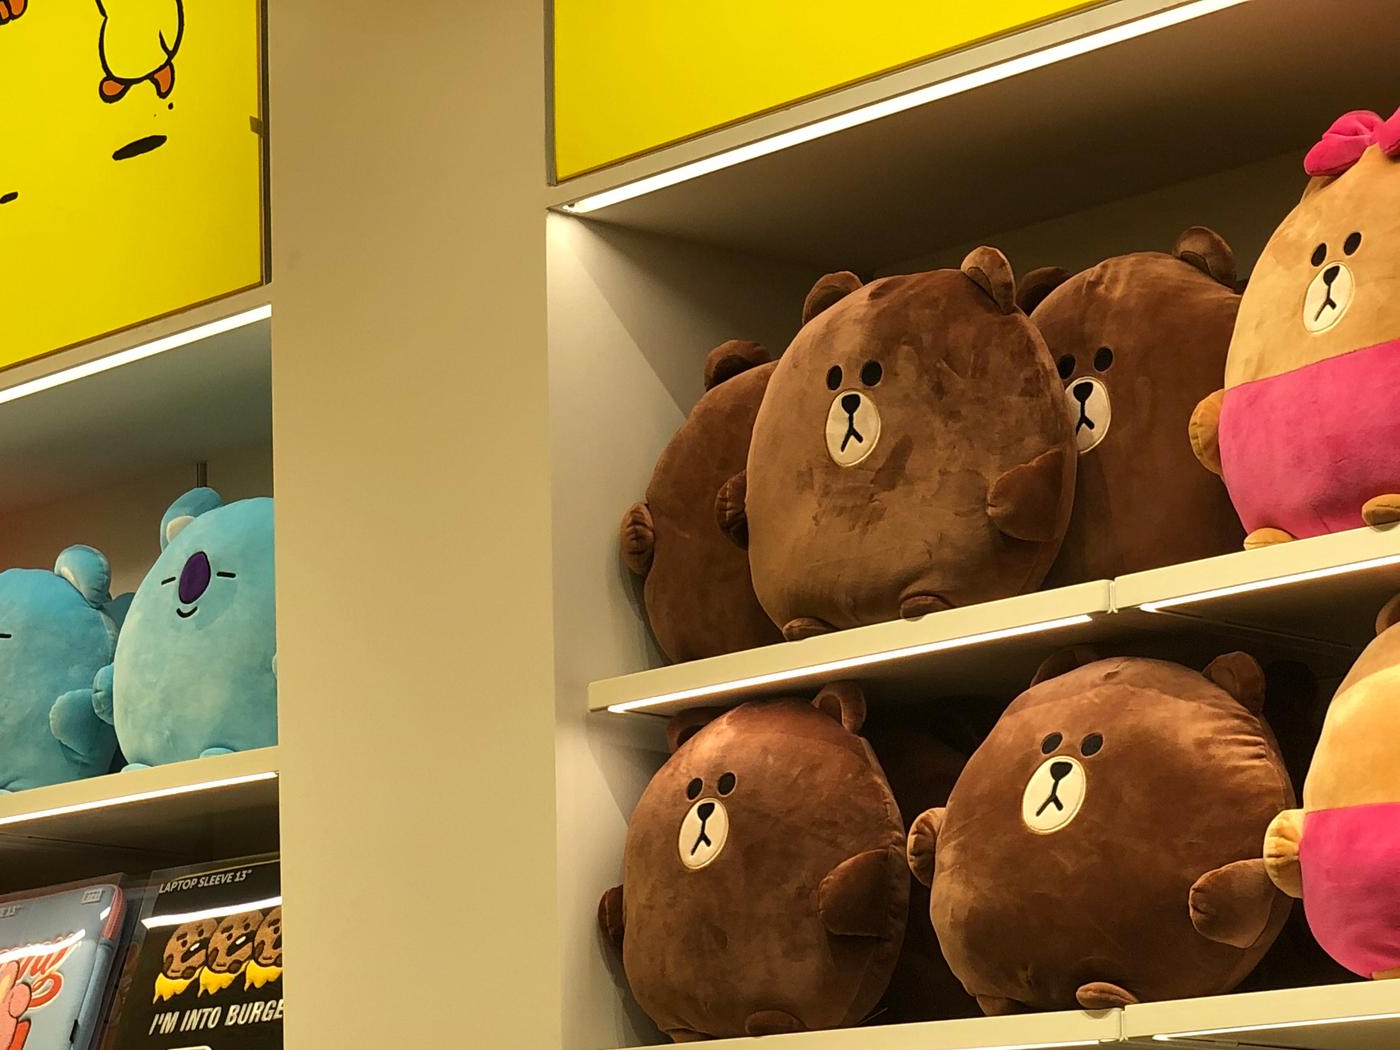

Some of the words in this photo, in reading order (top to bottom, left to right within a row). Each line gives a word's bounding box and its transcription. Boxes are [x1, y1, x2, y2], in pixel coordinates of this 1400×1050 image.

[159, 877, 198, 894] LAPTOP
[199, 873, 234, 888] SLEEVE
[149, 1011, 179, 1036] I'M
[180, 1006, 222, 1032] INTO
